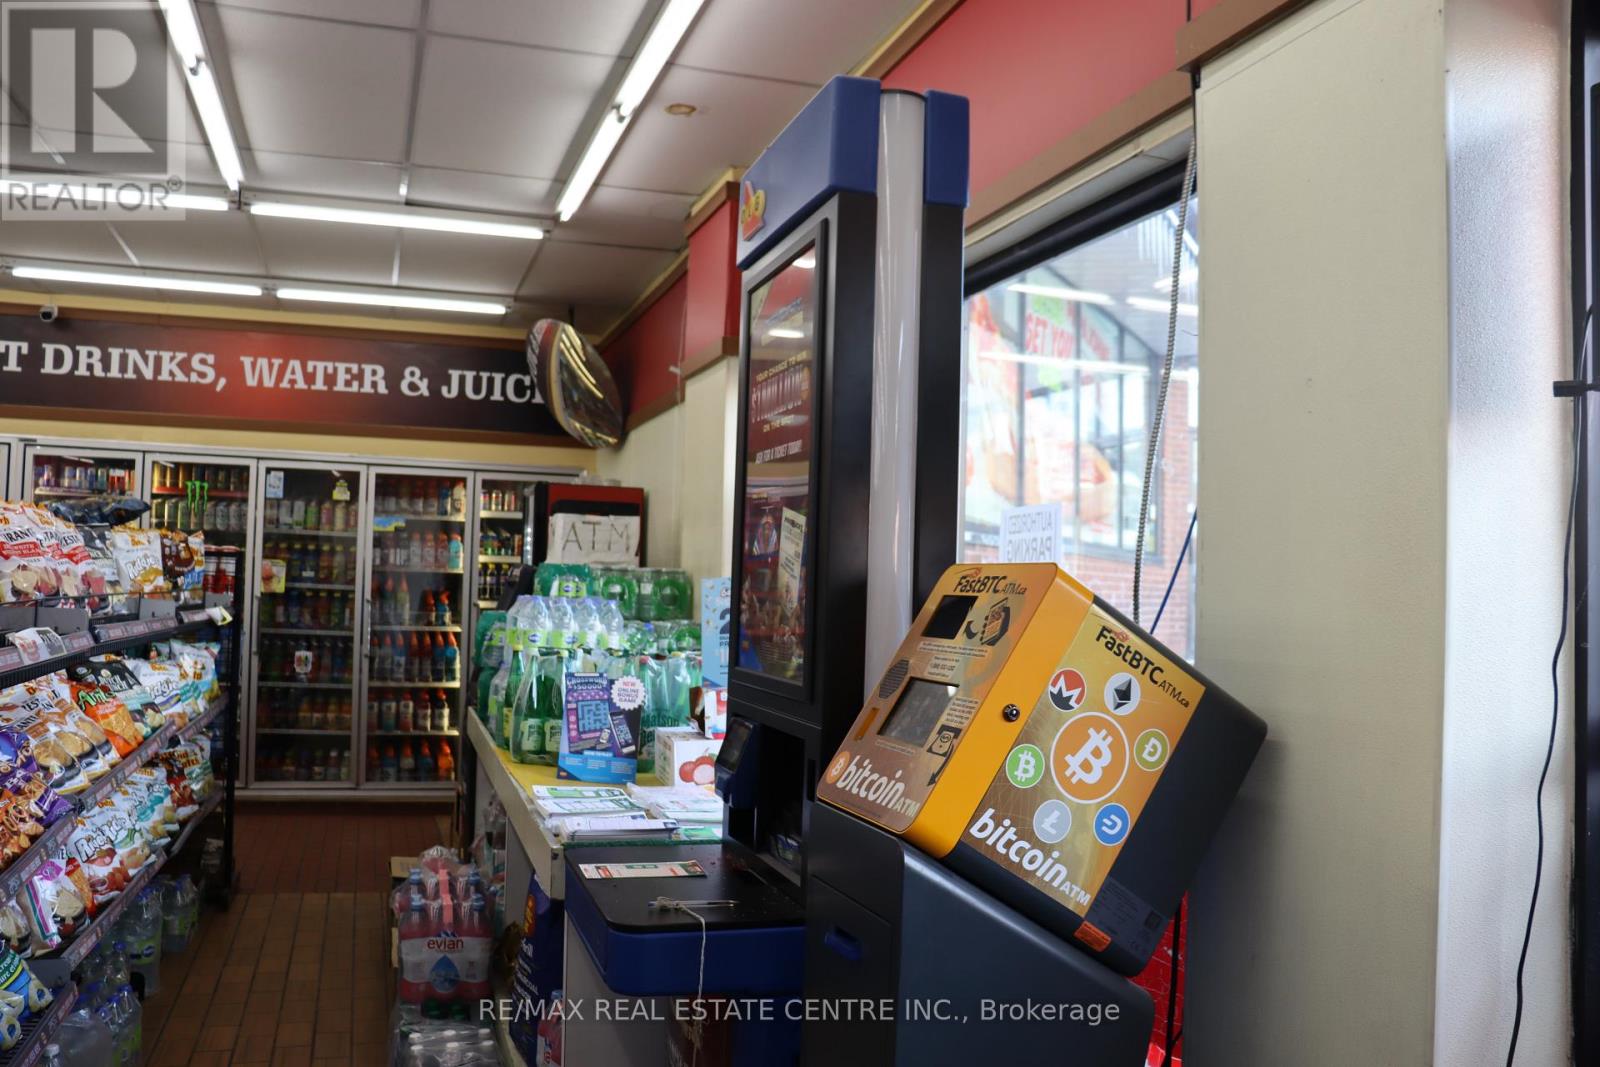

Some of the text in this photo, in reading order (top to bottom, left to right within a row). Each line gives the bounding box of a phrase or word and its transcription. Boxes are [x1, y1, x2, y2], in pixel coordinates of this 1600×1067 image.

[40, 343, 227, 393] DRINKS,
[240, 356, 388, 395] WATER
[400, 366, 430, 397] &
[562, 521, 630, 553] ATM
[427, 938, 464, 950] evian
